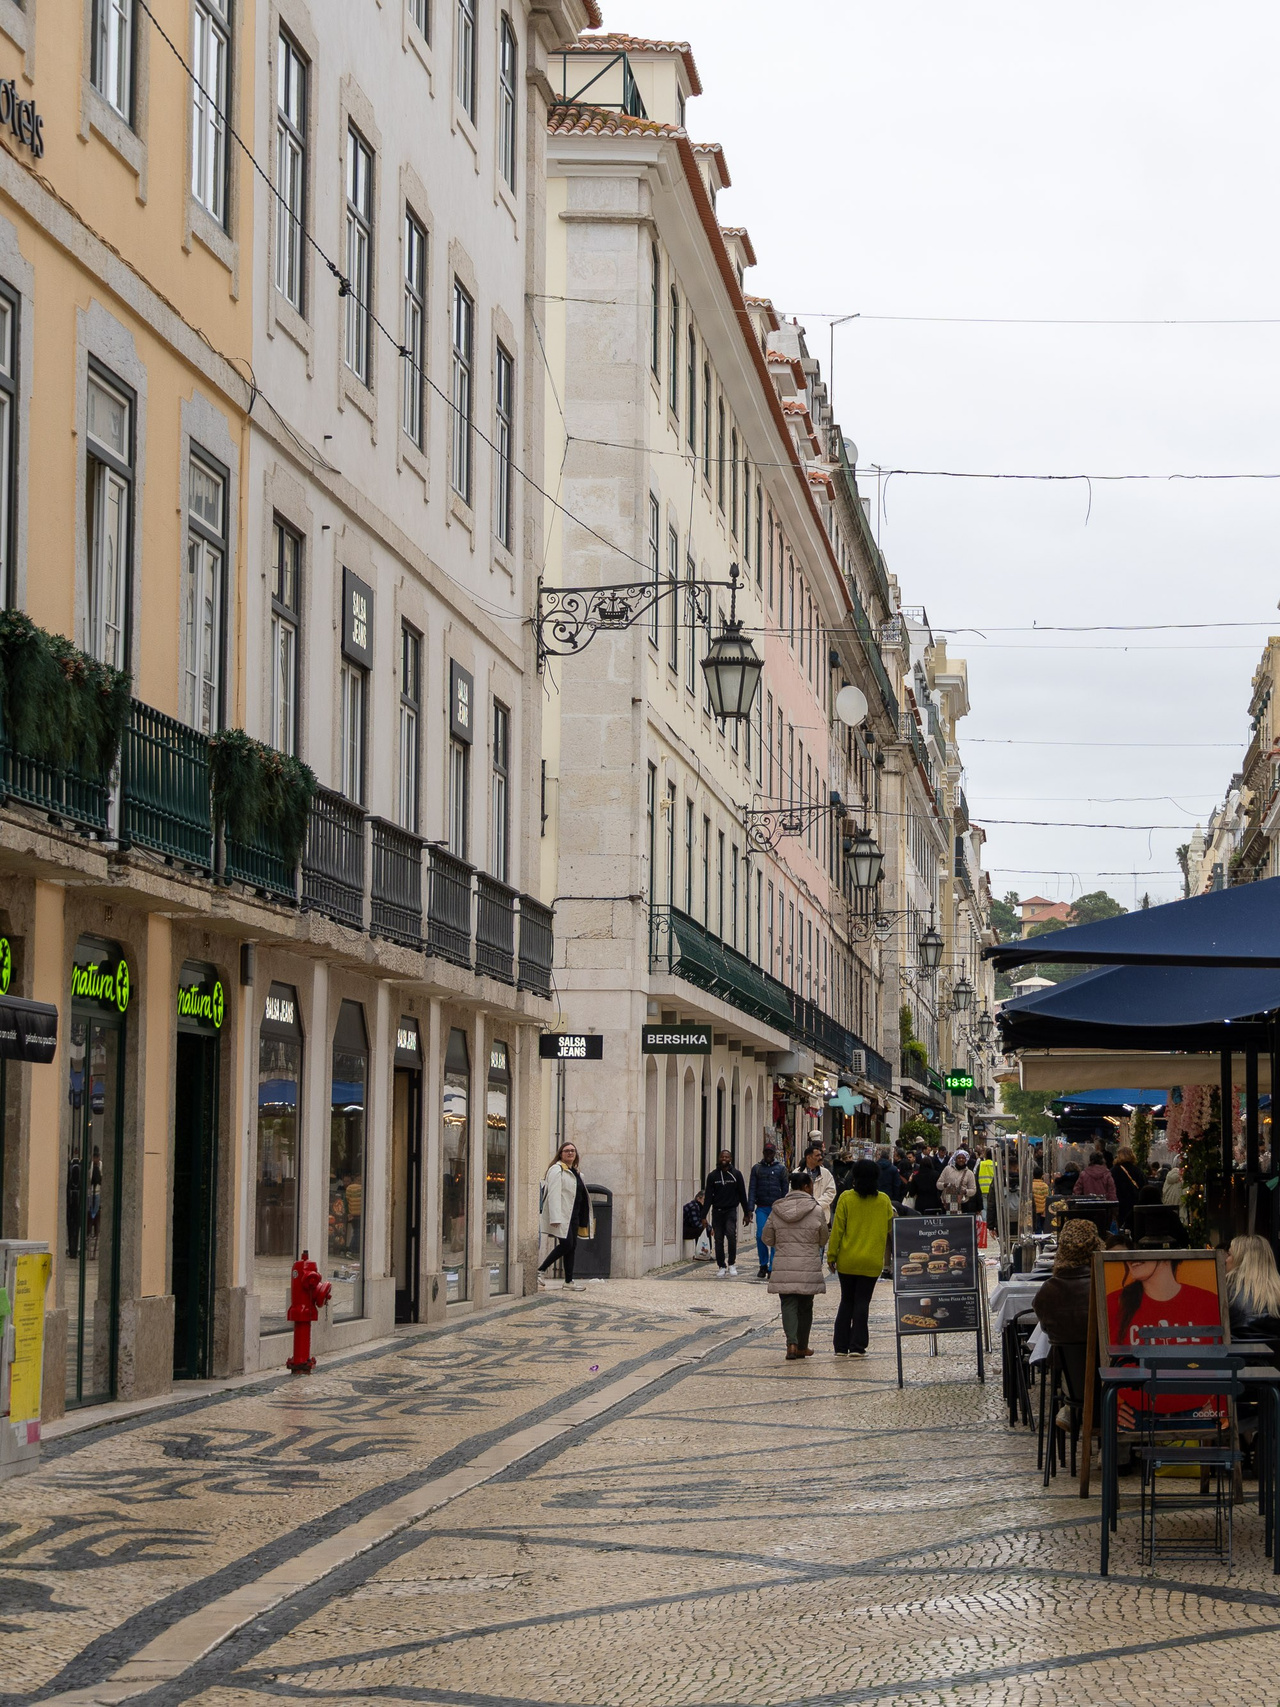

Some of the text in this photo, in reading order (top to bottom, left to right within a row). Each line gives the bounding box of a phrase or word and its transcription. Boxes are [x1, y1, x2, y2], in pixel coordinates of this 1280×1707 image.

[71, 962, 116, 1002] natura
[176, 984, 213, 1019] natura
[558, 1036, 586, 1047] SALSA
[647, 1034, 708, 1045] BERSHKA
[557, 1046, 586, 1057] JEANS
[924, 1218, 943, 1226] PAUL
